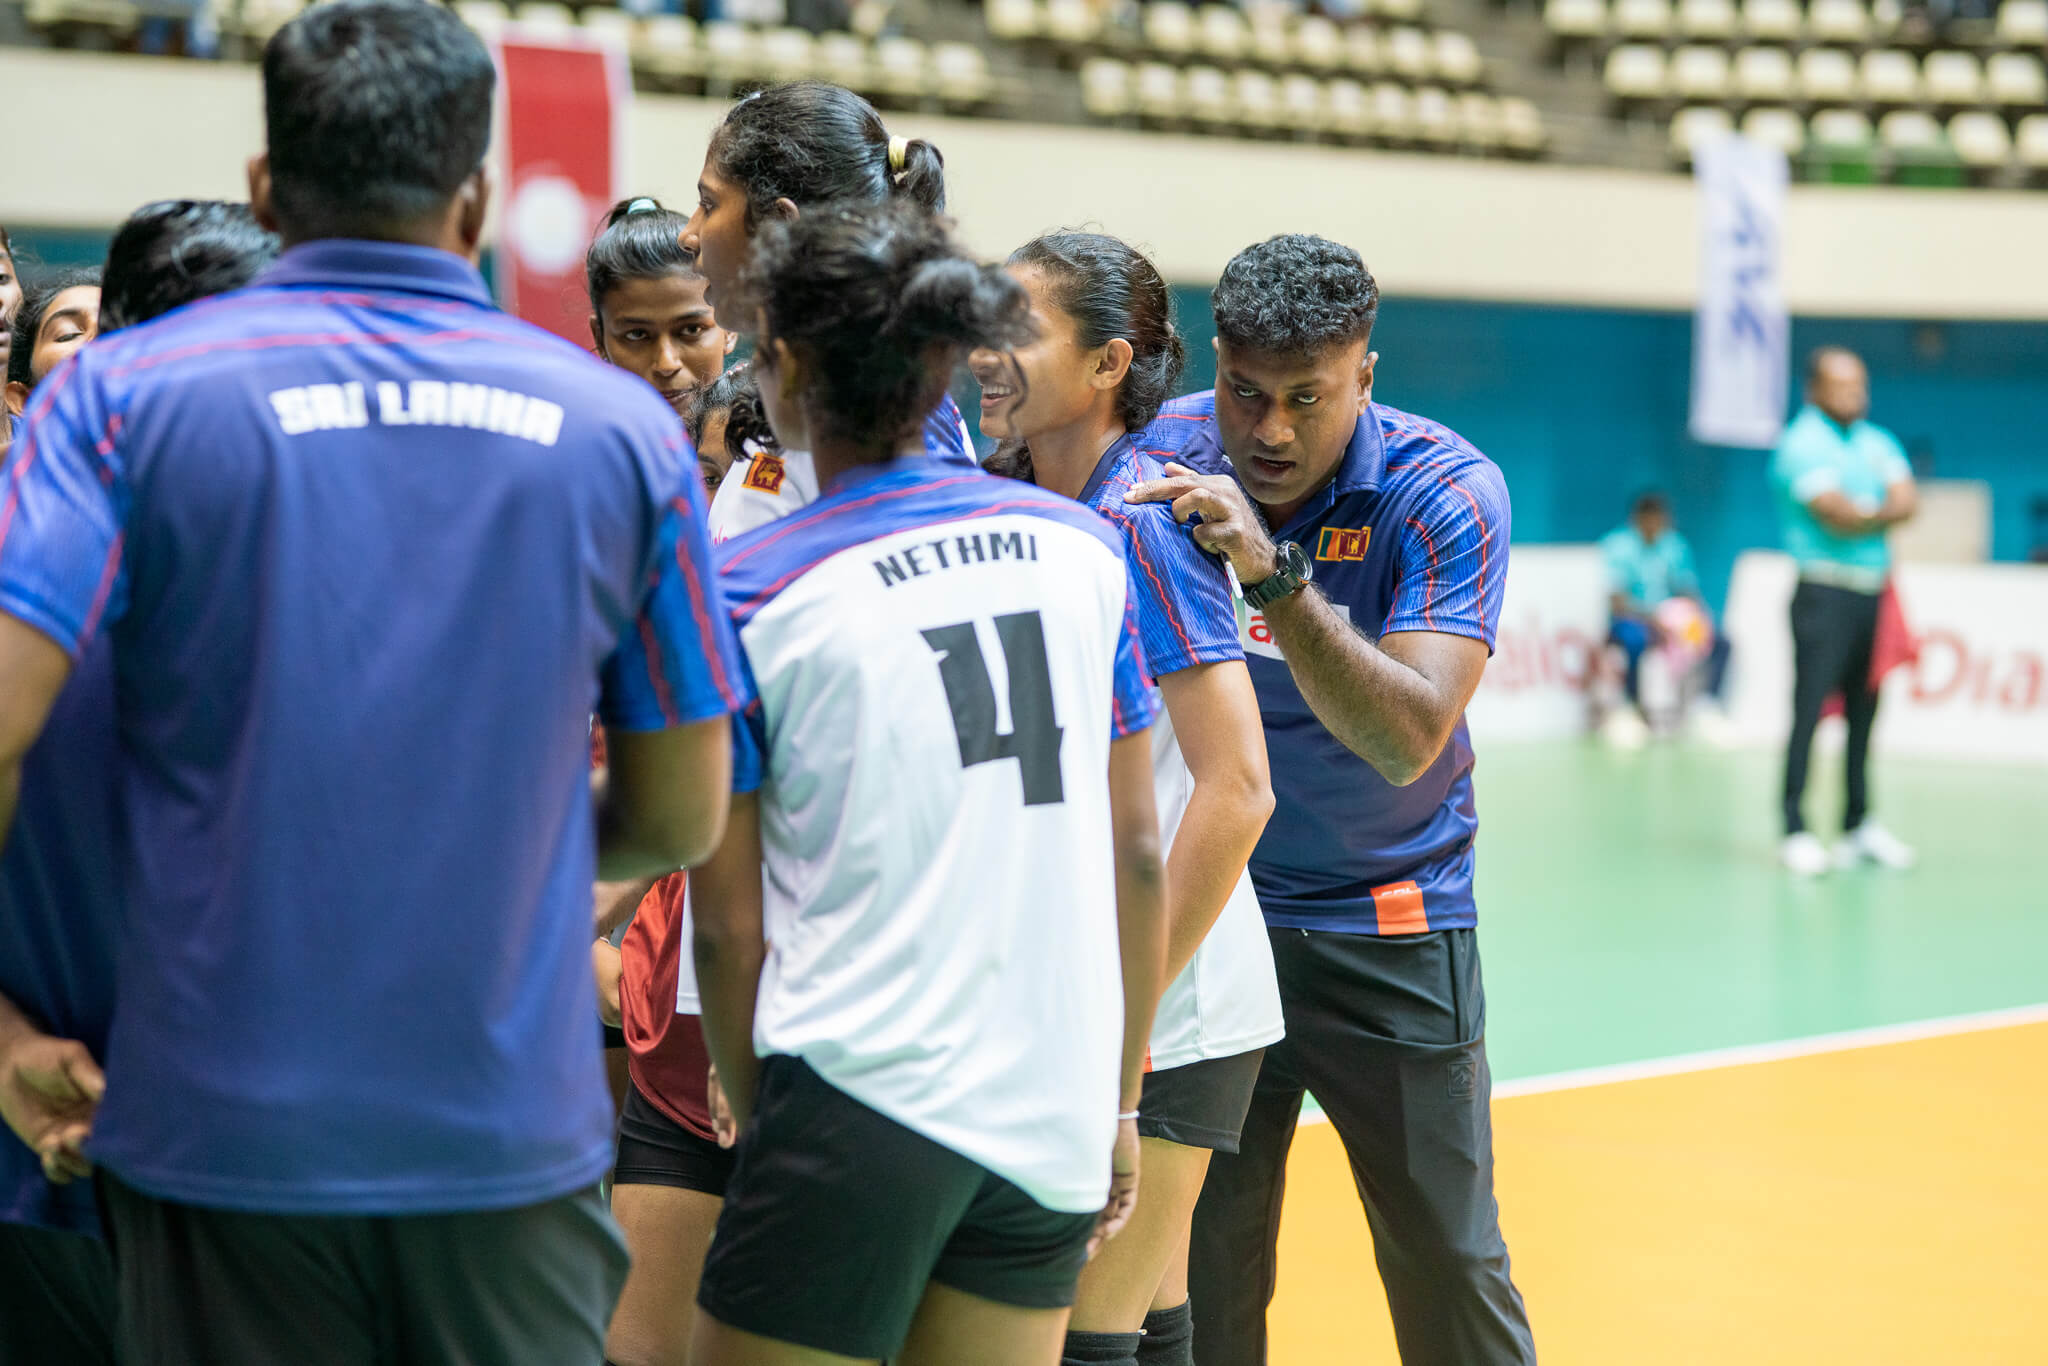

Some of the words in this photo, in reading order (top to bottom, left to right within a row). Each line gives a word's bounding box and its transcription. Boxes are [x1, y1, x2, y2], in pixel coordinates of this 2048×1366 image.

[269, 381, 369, 435] SRI
[376, 380, 564, 446] LANKA
[873, 532, 1037, 587] NETHMI
[919, 611, 1065, 806] 4
